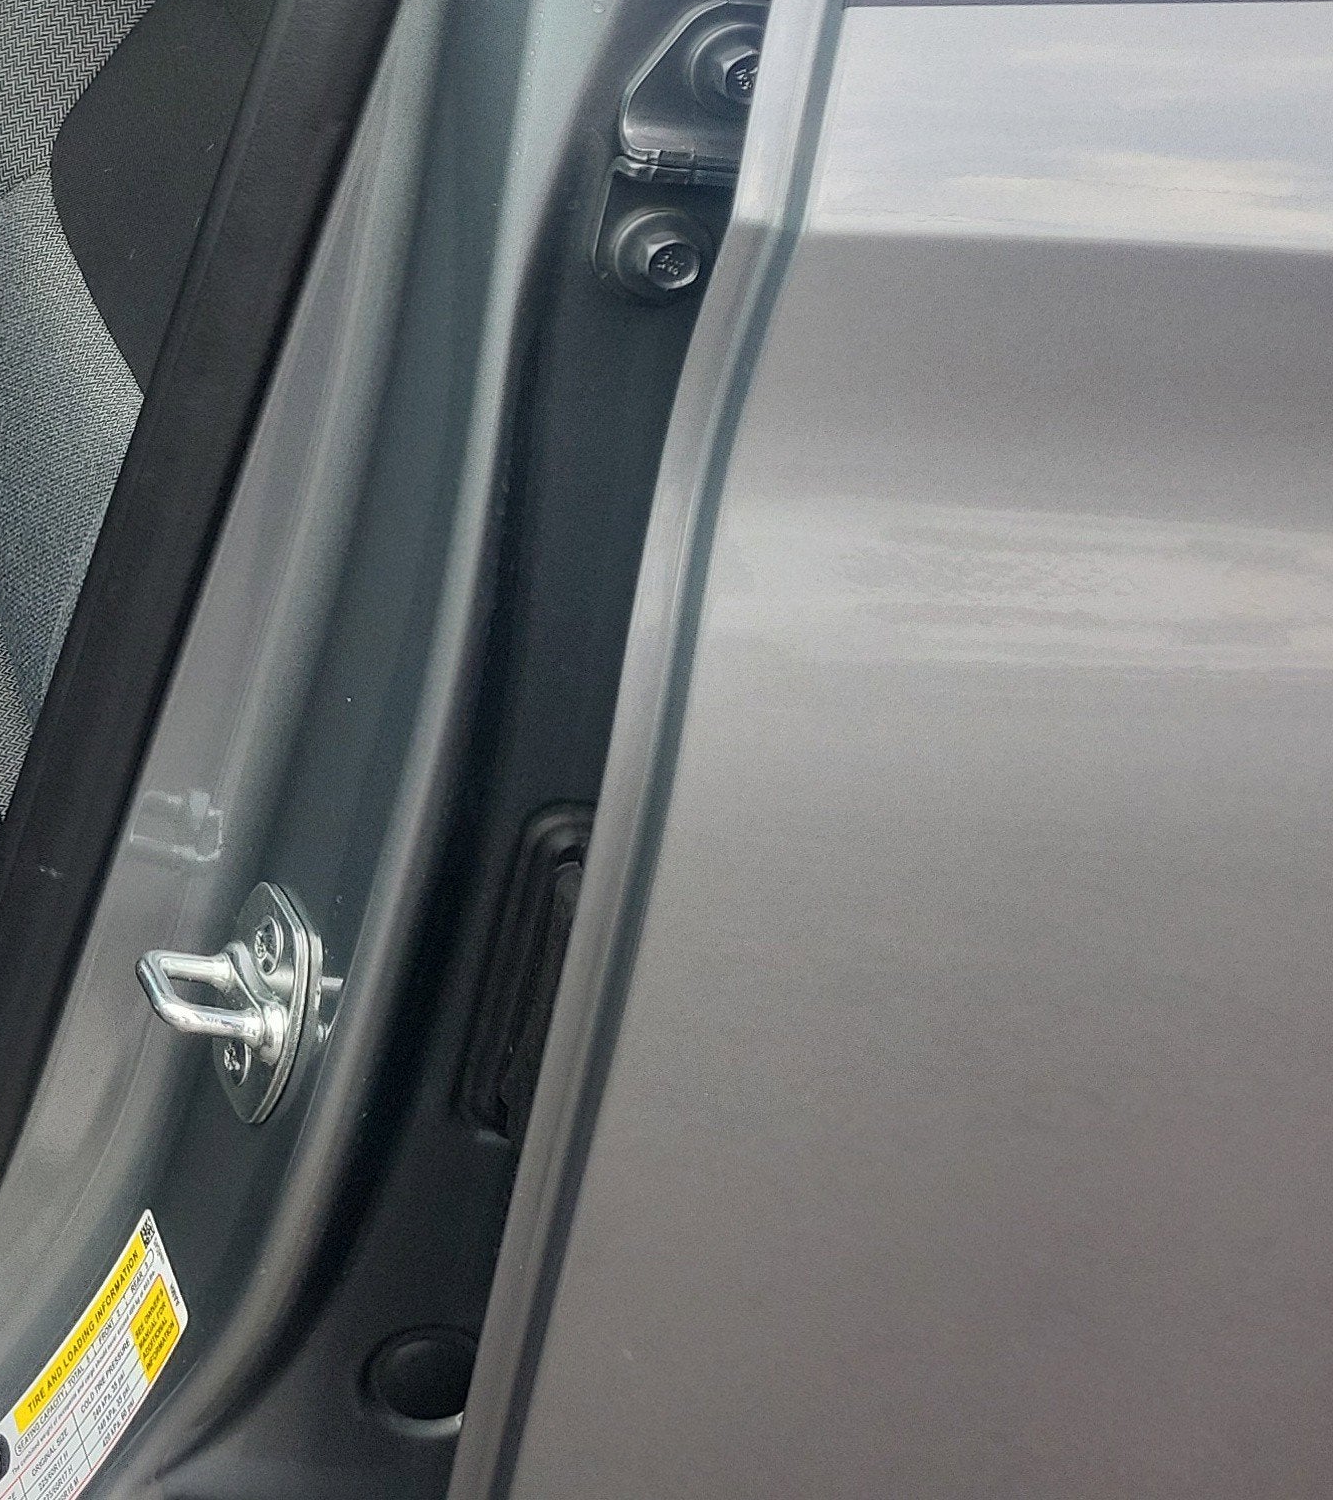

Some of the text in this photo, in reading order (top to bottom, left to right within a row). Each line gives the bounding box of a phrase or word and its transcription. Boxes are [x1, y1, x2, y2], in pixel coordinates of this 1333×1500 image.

[17, 1424, 40, 1452] SEATING
[68, 1365, 85, 1387] TOTAL
[98, 1319, 115, 1344] FRONT
[130, 1271, 144, 1293] REAR
[27, 1250, 139, 1413] TIRE AND LOADING INFORMATION
[80, 1393, 94, 1413] COLD
[106, 1338, 130, 1378] PRESSURE
